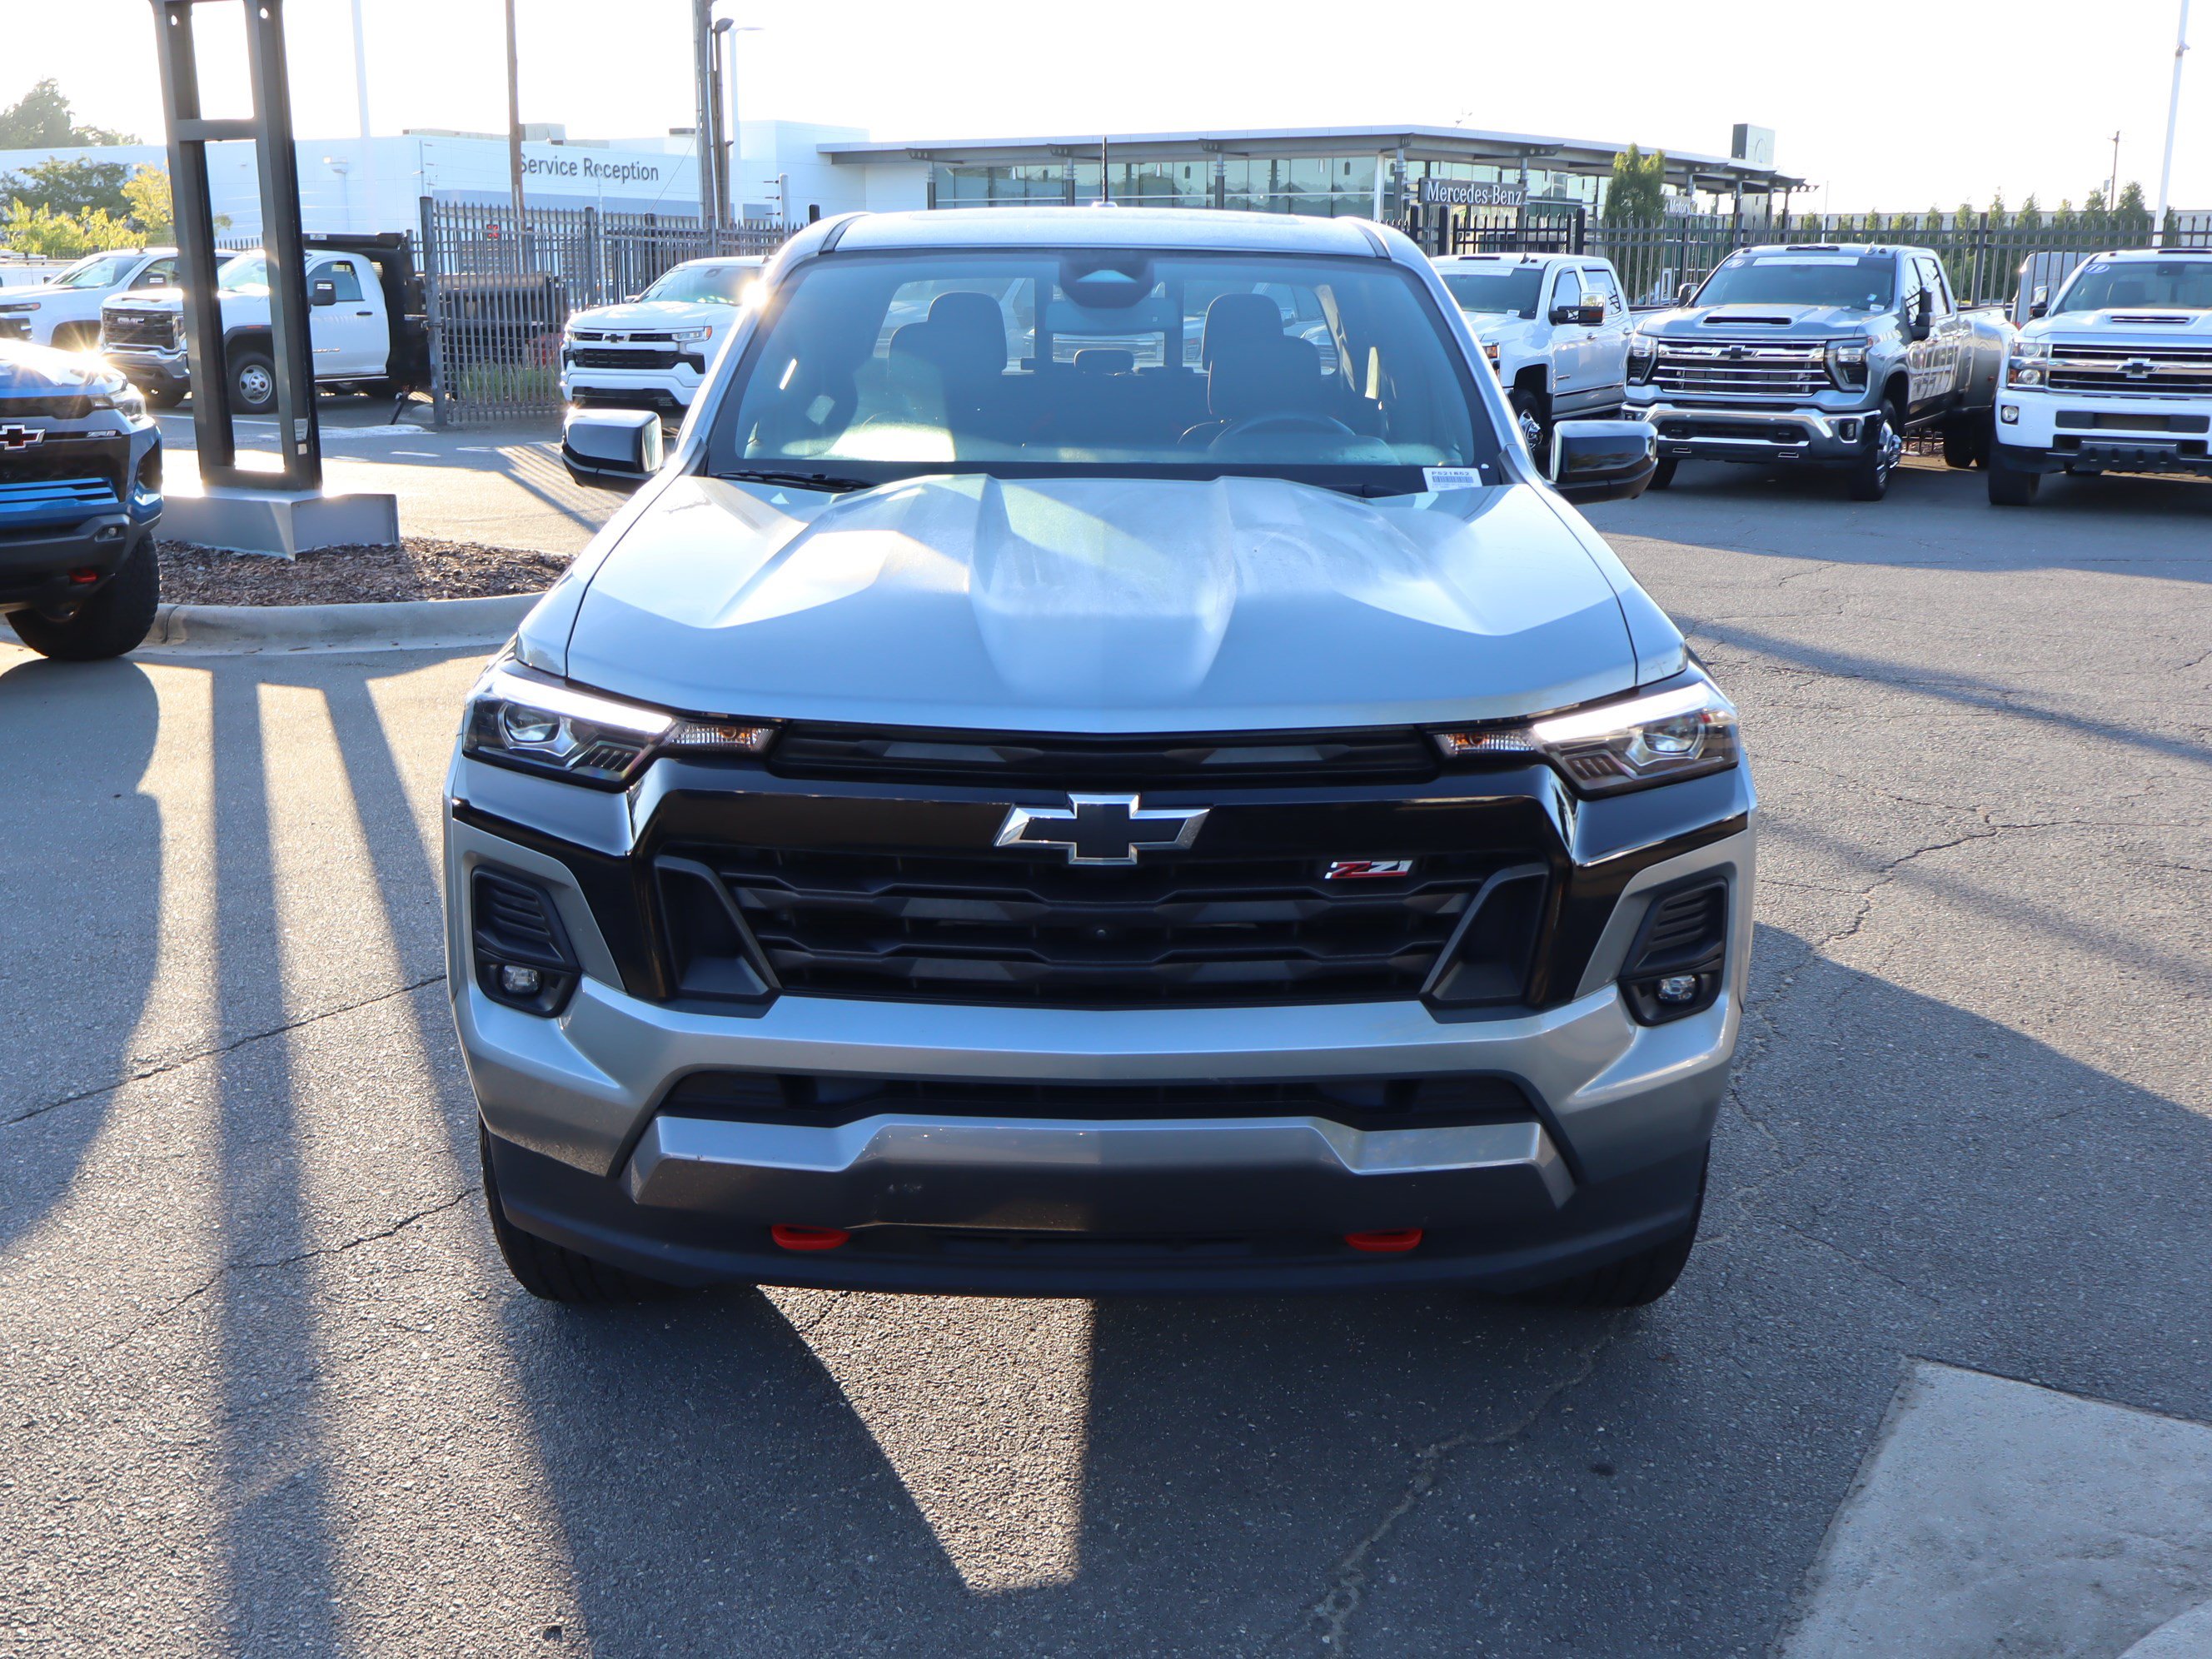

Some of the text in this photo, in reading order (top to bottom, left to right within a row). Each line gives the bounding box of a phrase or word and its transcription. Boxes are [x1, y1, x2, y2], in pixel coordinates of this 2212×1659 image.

[521, 152, 659, 184] Service Reception
[1426, 180, 1522, 206] Mercedes-Benz
